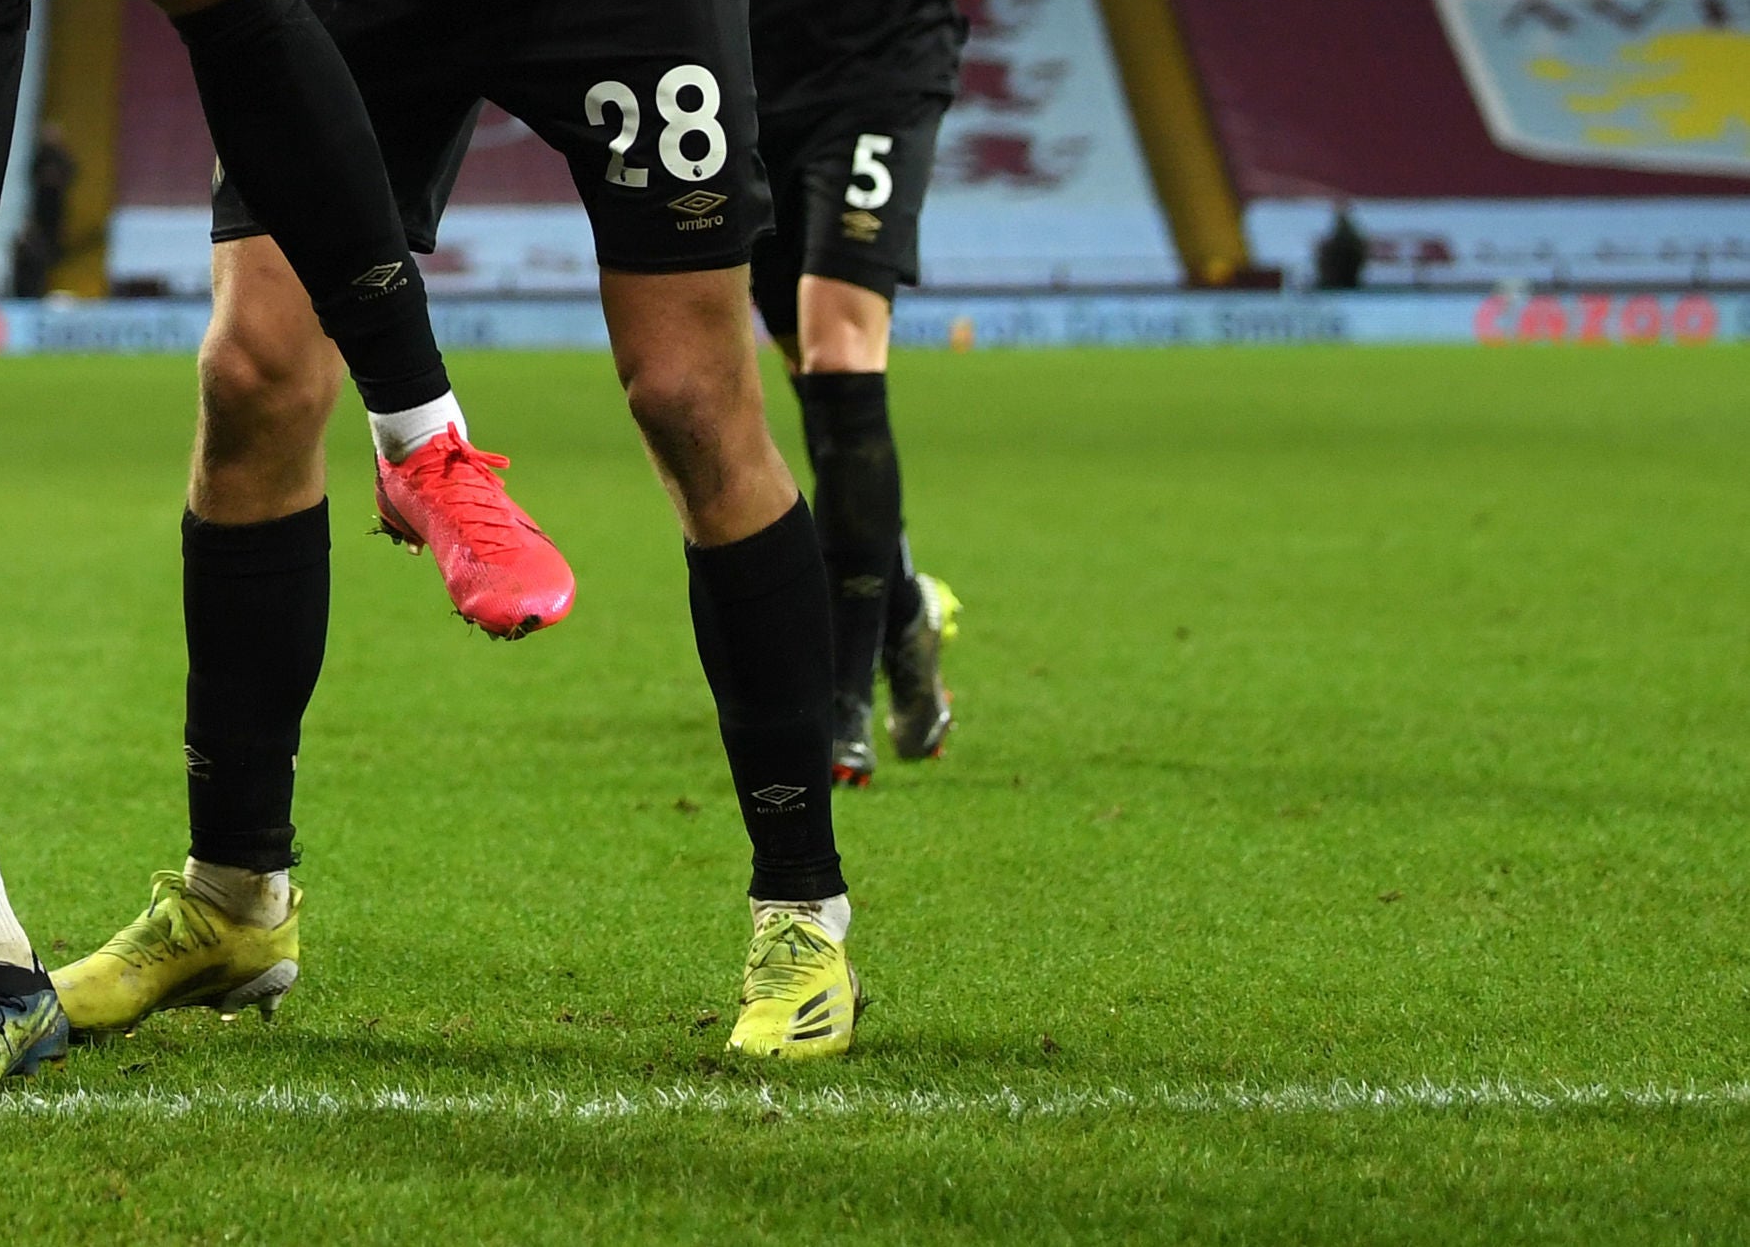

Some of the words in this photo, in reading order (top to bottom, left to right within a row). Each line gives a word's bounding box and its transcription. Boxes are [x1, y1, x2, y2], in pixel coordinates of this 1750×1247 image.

[583, 64, 728, 188] 28
[844, 133, 894, 210] 5
[675, 214, 724, 232] umbro
